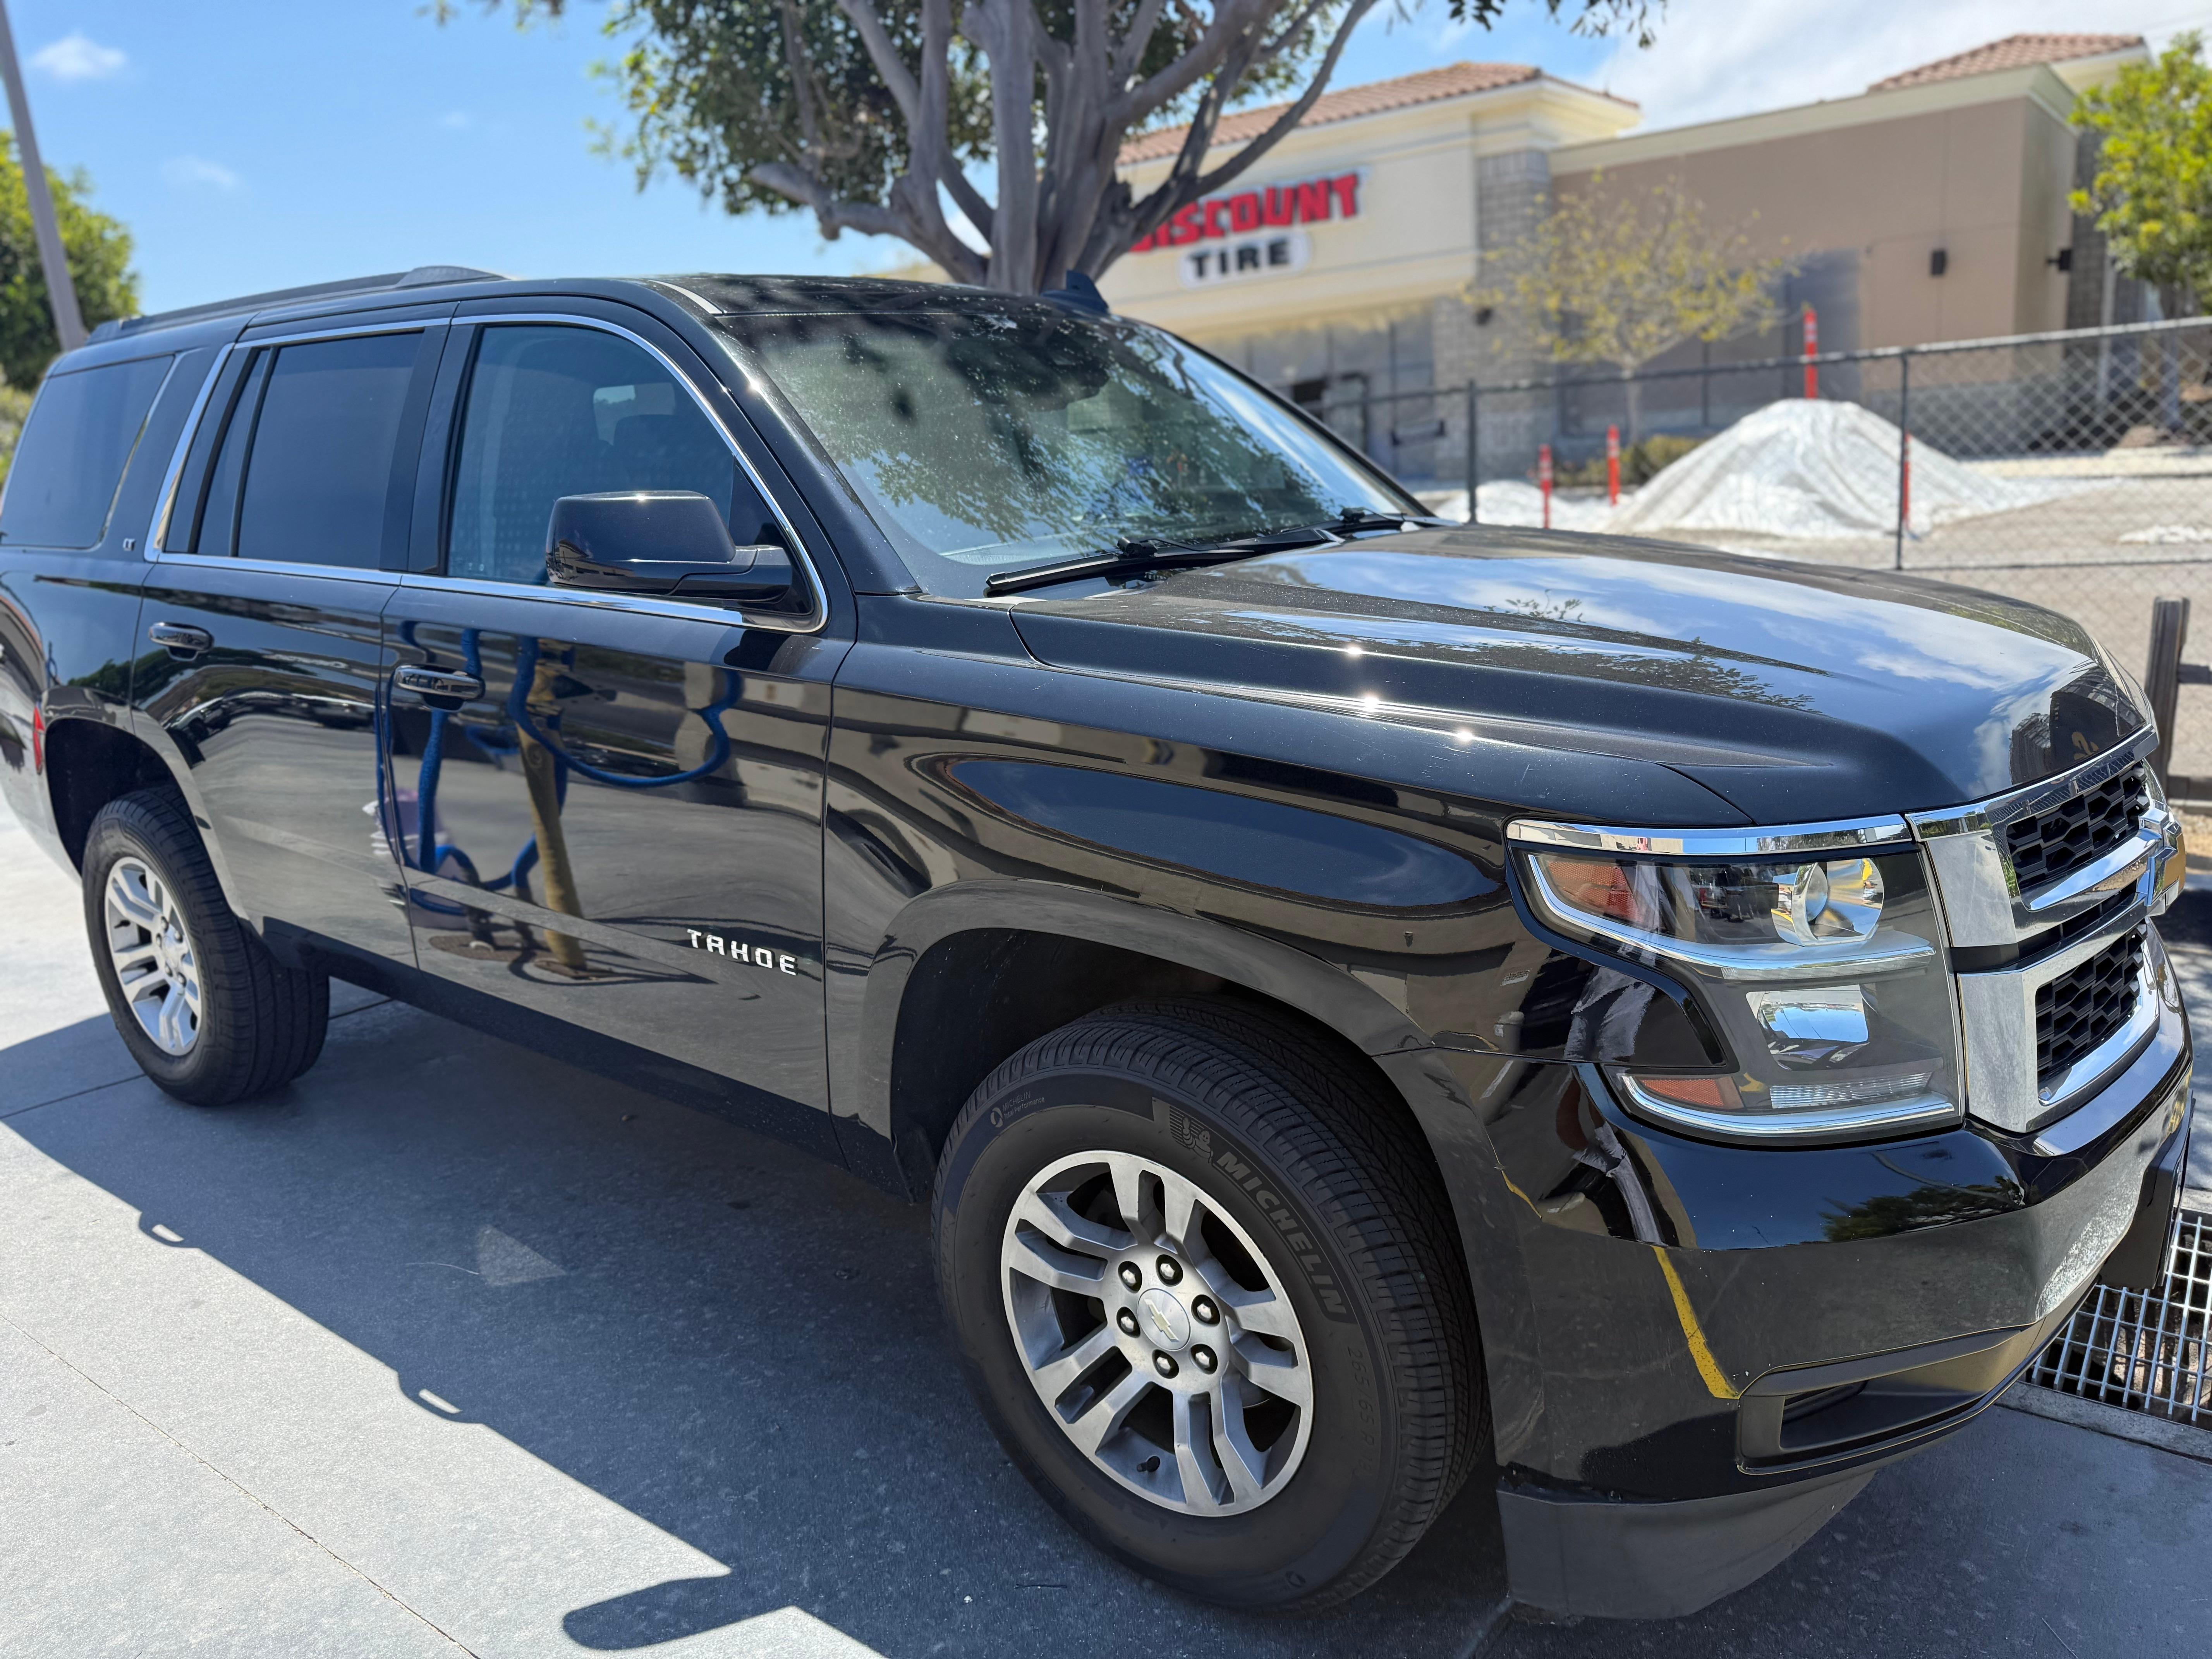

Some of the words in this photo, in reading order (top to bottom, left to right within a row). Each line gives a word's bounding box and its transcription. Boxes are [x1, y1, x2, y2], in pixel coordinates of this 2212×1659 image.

[1128, 173, 1358, 253] ISCOUNT
[1189, 238, 1290, 278] TIRE
[687, 929, 797, 976] TAHOE
[1002, 1090, 1031, 1112] MICHELIN
[1216, 1151, 1347, 1314] MICHELIN
